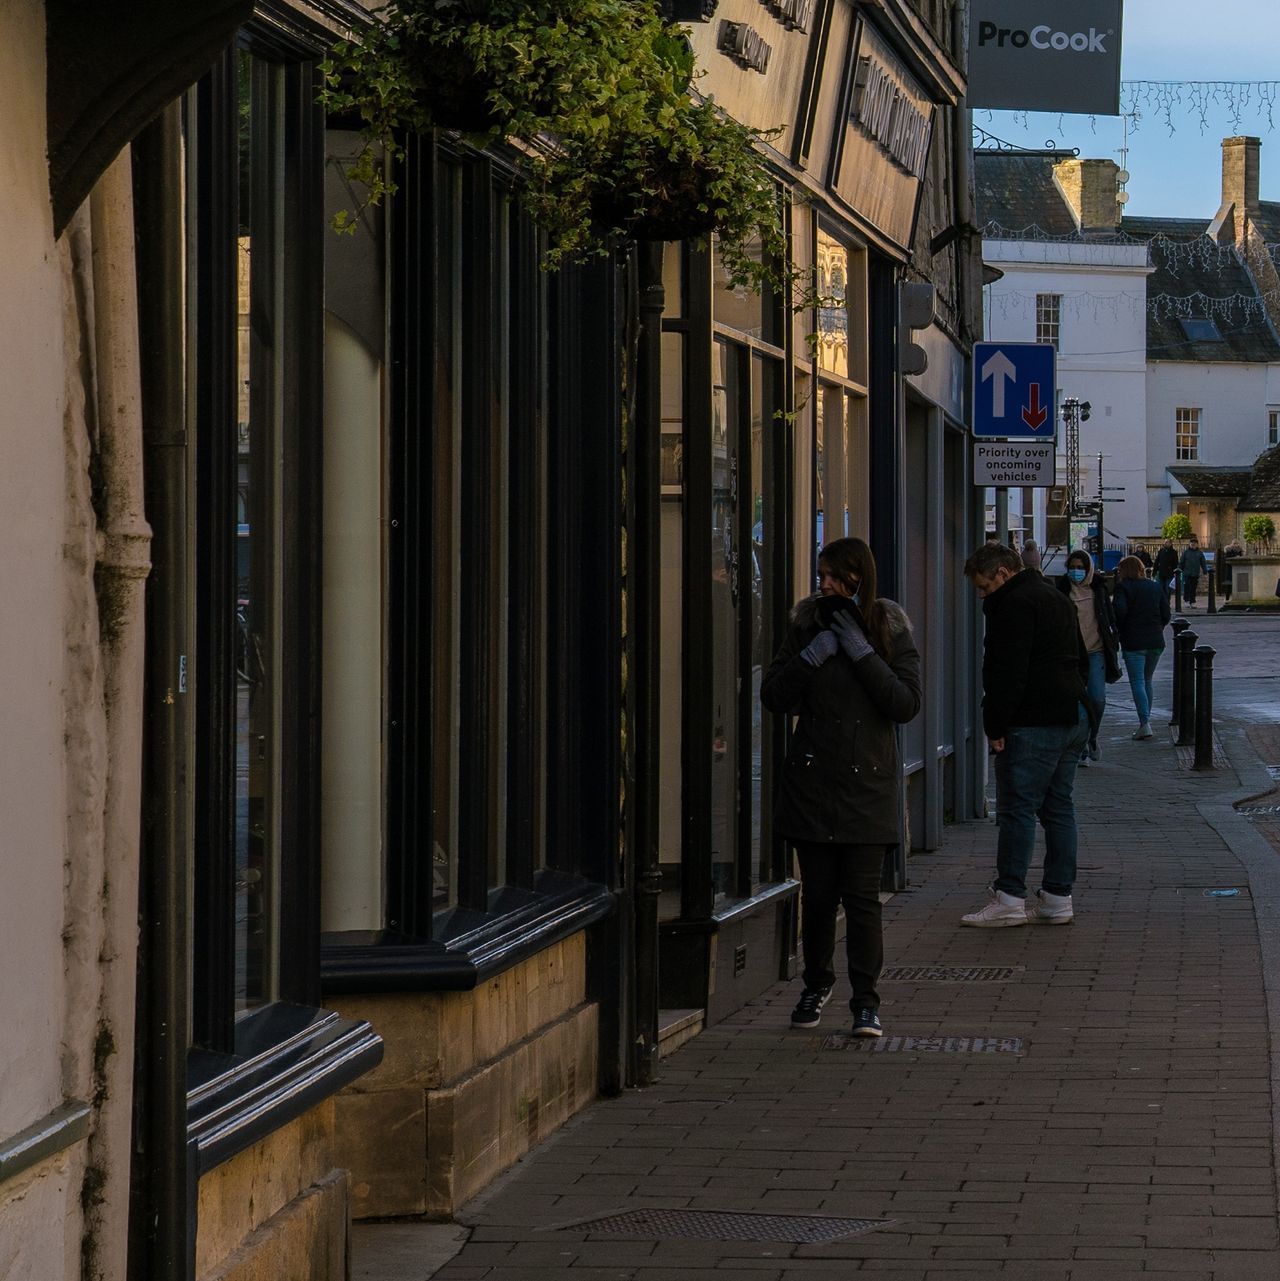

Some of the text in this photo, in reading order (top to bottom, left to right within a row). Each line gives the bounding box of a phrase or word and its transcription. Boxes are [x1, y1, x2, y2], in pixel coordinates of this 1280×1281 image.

[977, 21, 1108, 54] ProCook
[978, 447, 1050, 458] Priority over
[986, 459, 1042, 471] oncoming
[990, 472, 1037, 481] vehicles
